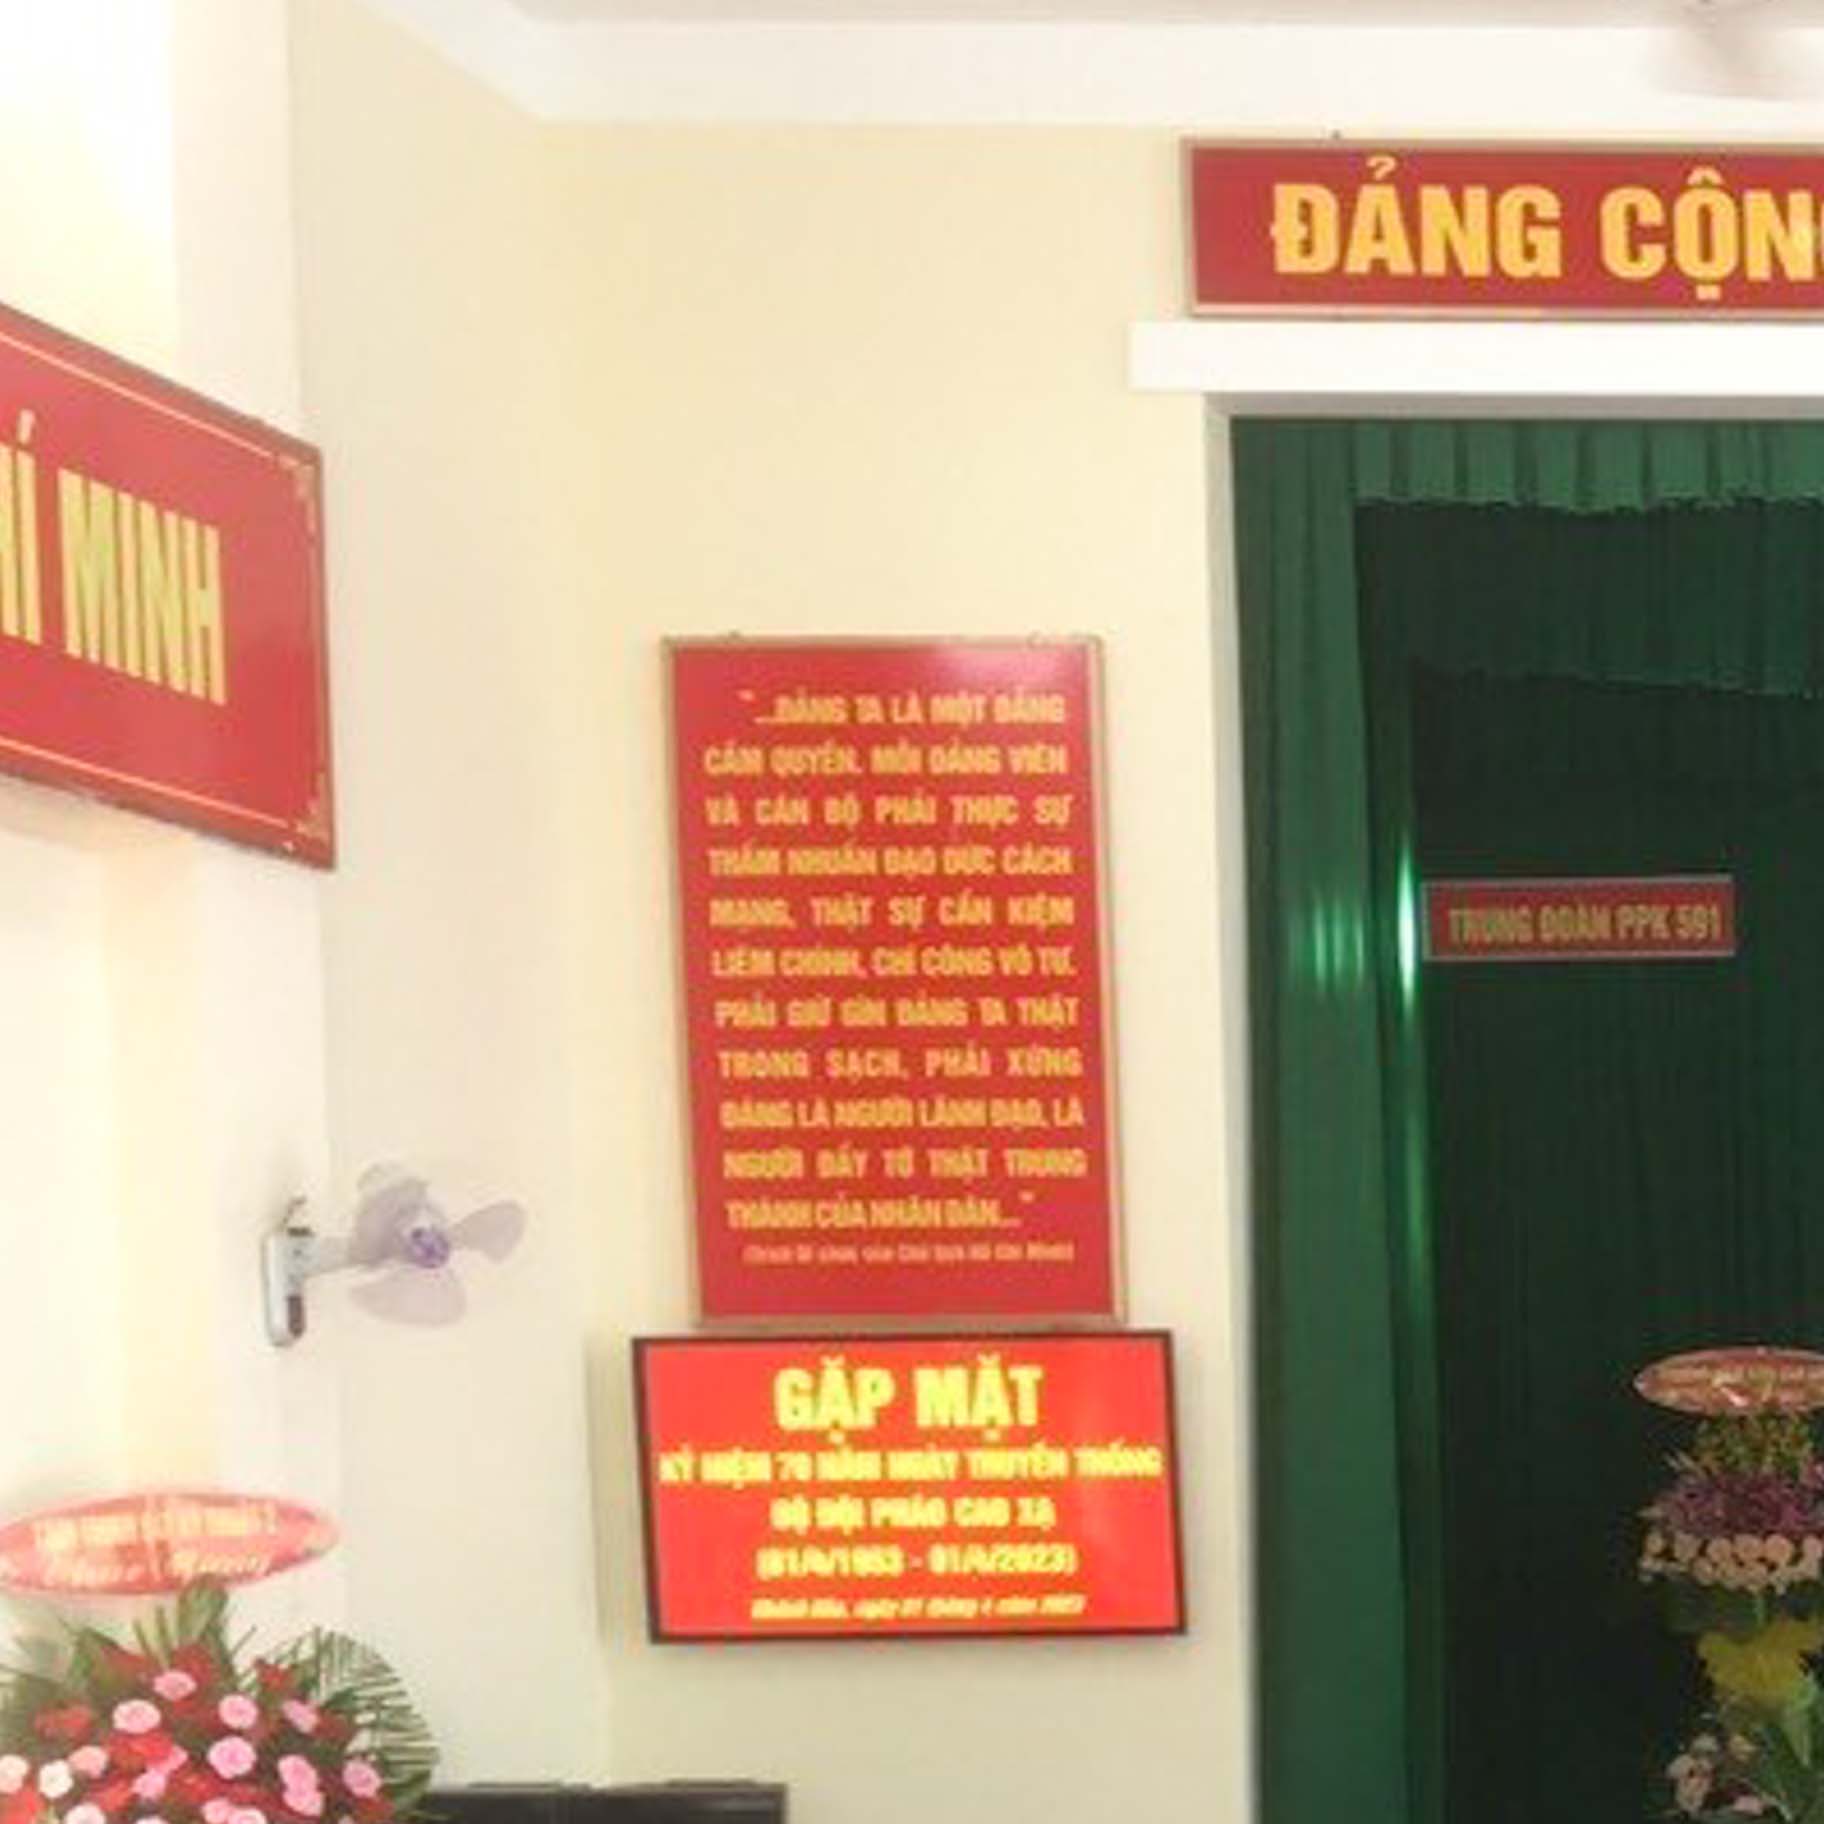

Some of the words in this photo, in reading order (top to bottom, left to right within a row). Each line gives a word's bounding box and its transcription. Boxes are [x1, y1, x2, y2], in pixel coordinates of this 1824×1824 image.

[1271, 155, 1561, 278] ĐẢNG
[57, 465, 227, 707] MINH
[1615, 904, 1670, 940] PPK
[1671, 902, 1721, 940] 591
[774, 1356, 896, 1445] GẶP
[913, 1354, 1042, 1443] MẶT
